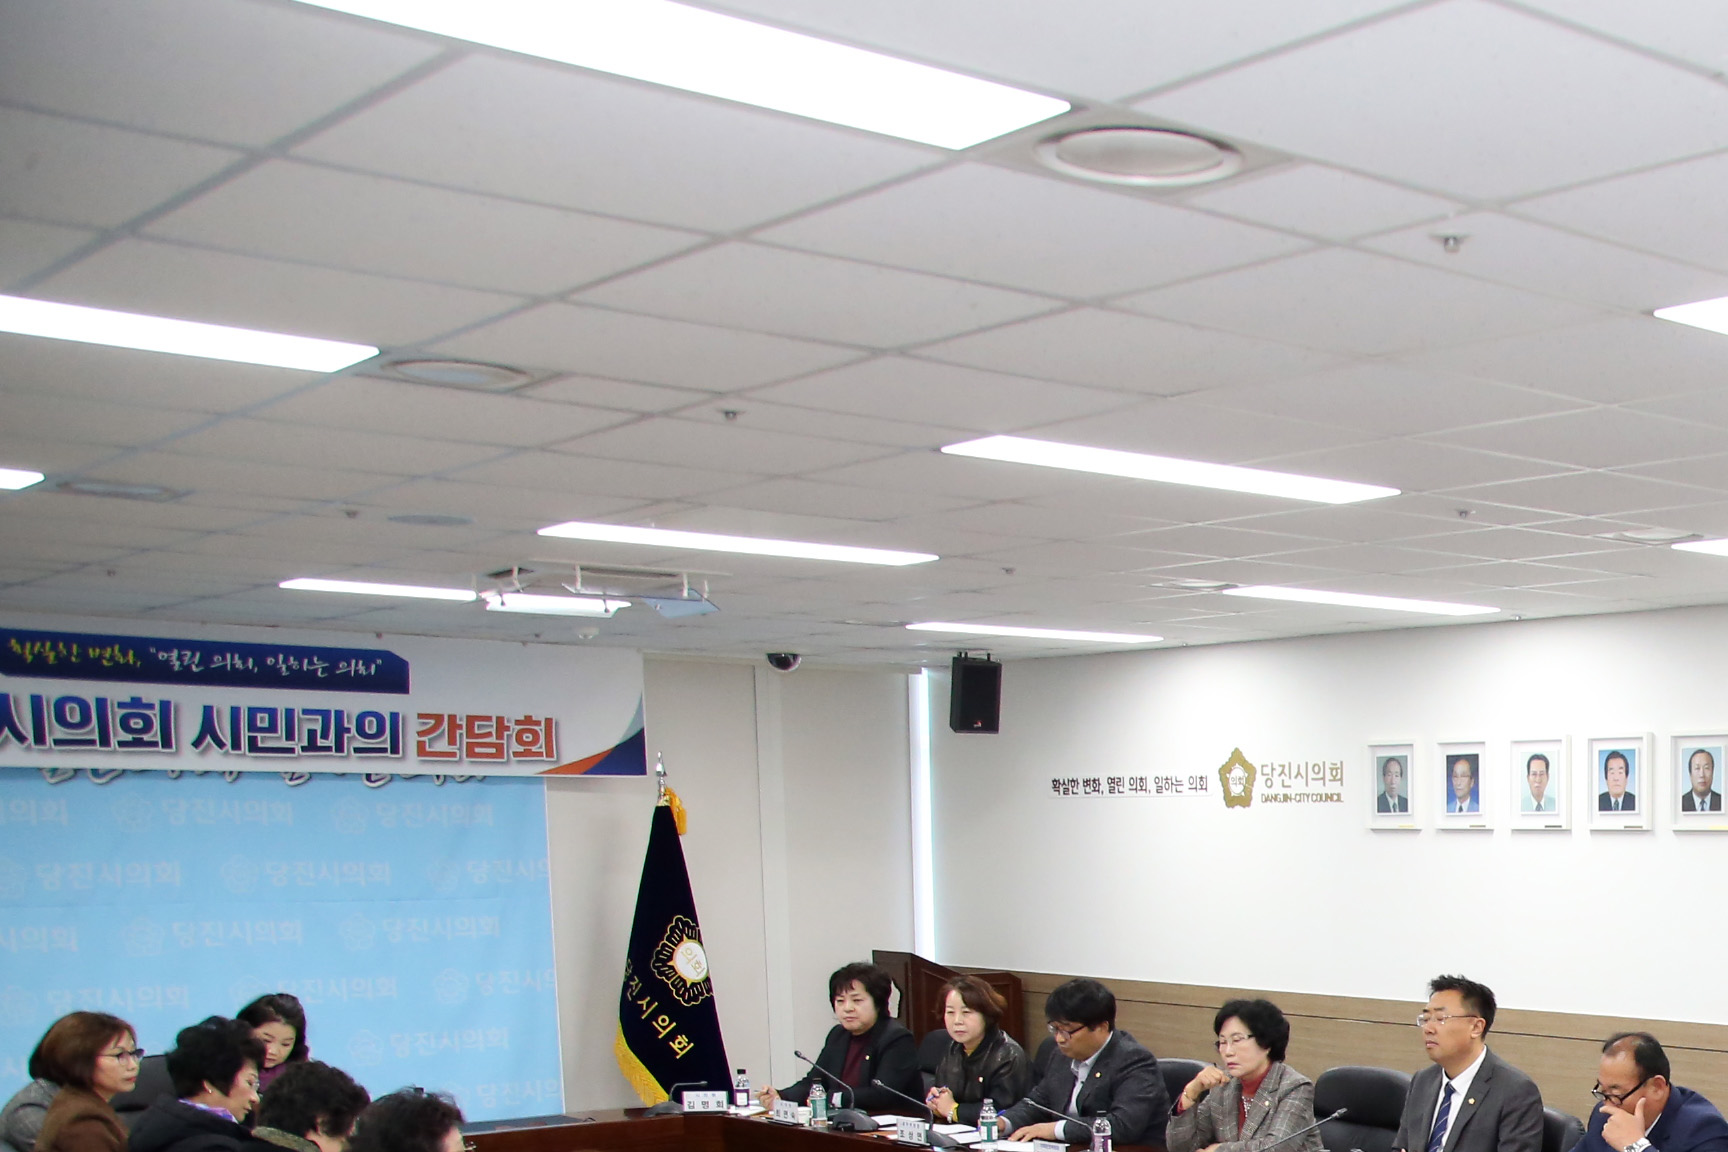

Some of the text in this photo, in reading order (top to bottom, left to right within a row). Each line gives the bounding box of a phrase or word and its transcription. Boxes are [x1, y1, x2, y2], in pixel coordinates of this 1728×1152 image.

[0, 693, 556, 760] 시의회 시민과의 간담회
[1052, 775, 1208, 796] 확실한 변화, 열린 의회, 일하는 의회
[1260, 761, 1344, 788] 당진시의회
[376, 803, 494, 828] 당진시의회
[265, 860, 392, 888] 당진시의회
